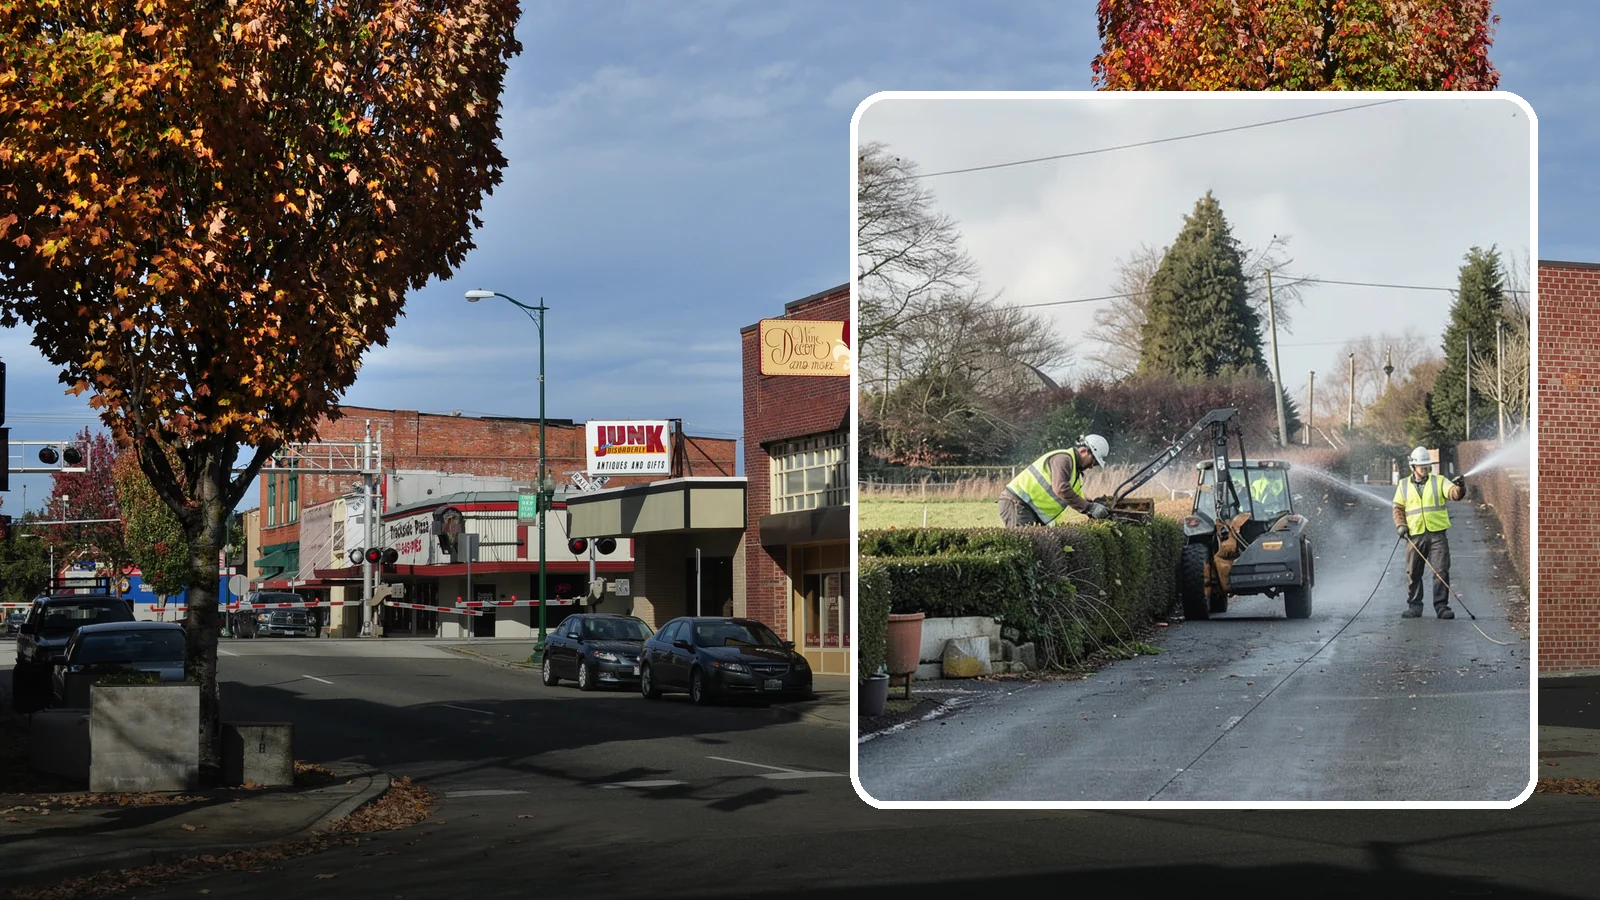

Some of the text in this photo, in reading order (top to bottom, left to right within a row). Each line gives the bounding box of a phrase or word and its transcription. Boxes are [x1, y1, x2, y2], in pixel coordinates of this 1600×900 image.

[595, 425, 664, 457] JUNK
[597, 460, 665, 470] ANTIQUES AND GIFTS
